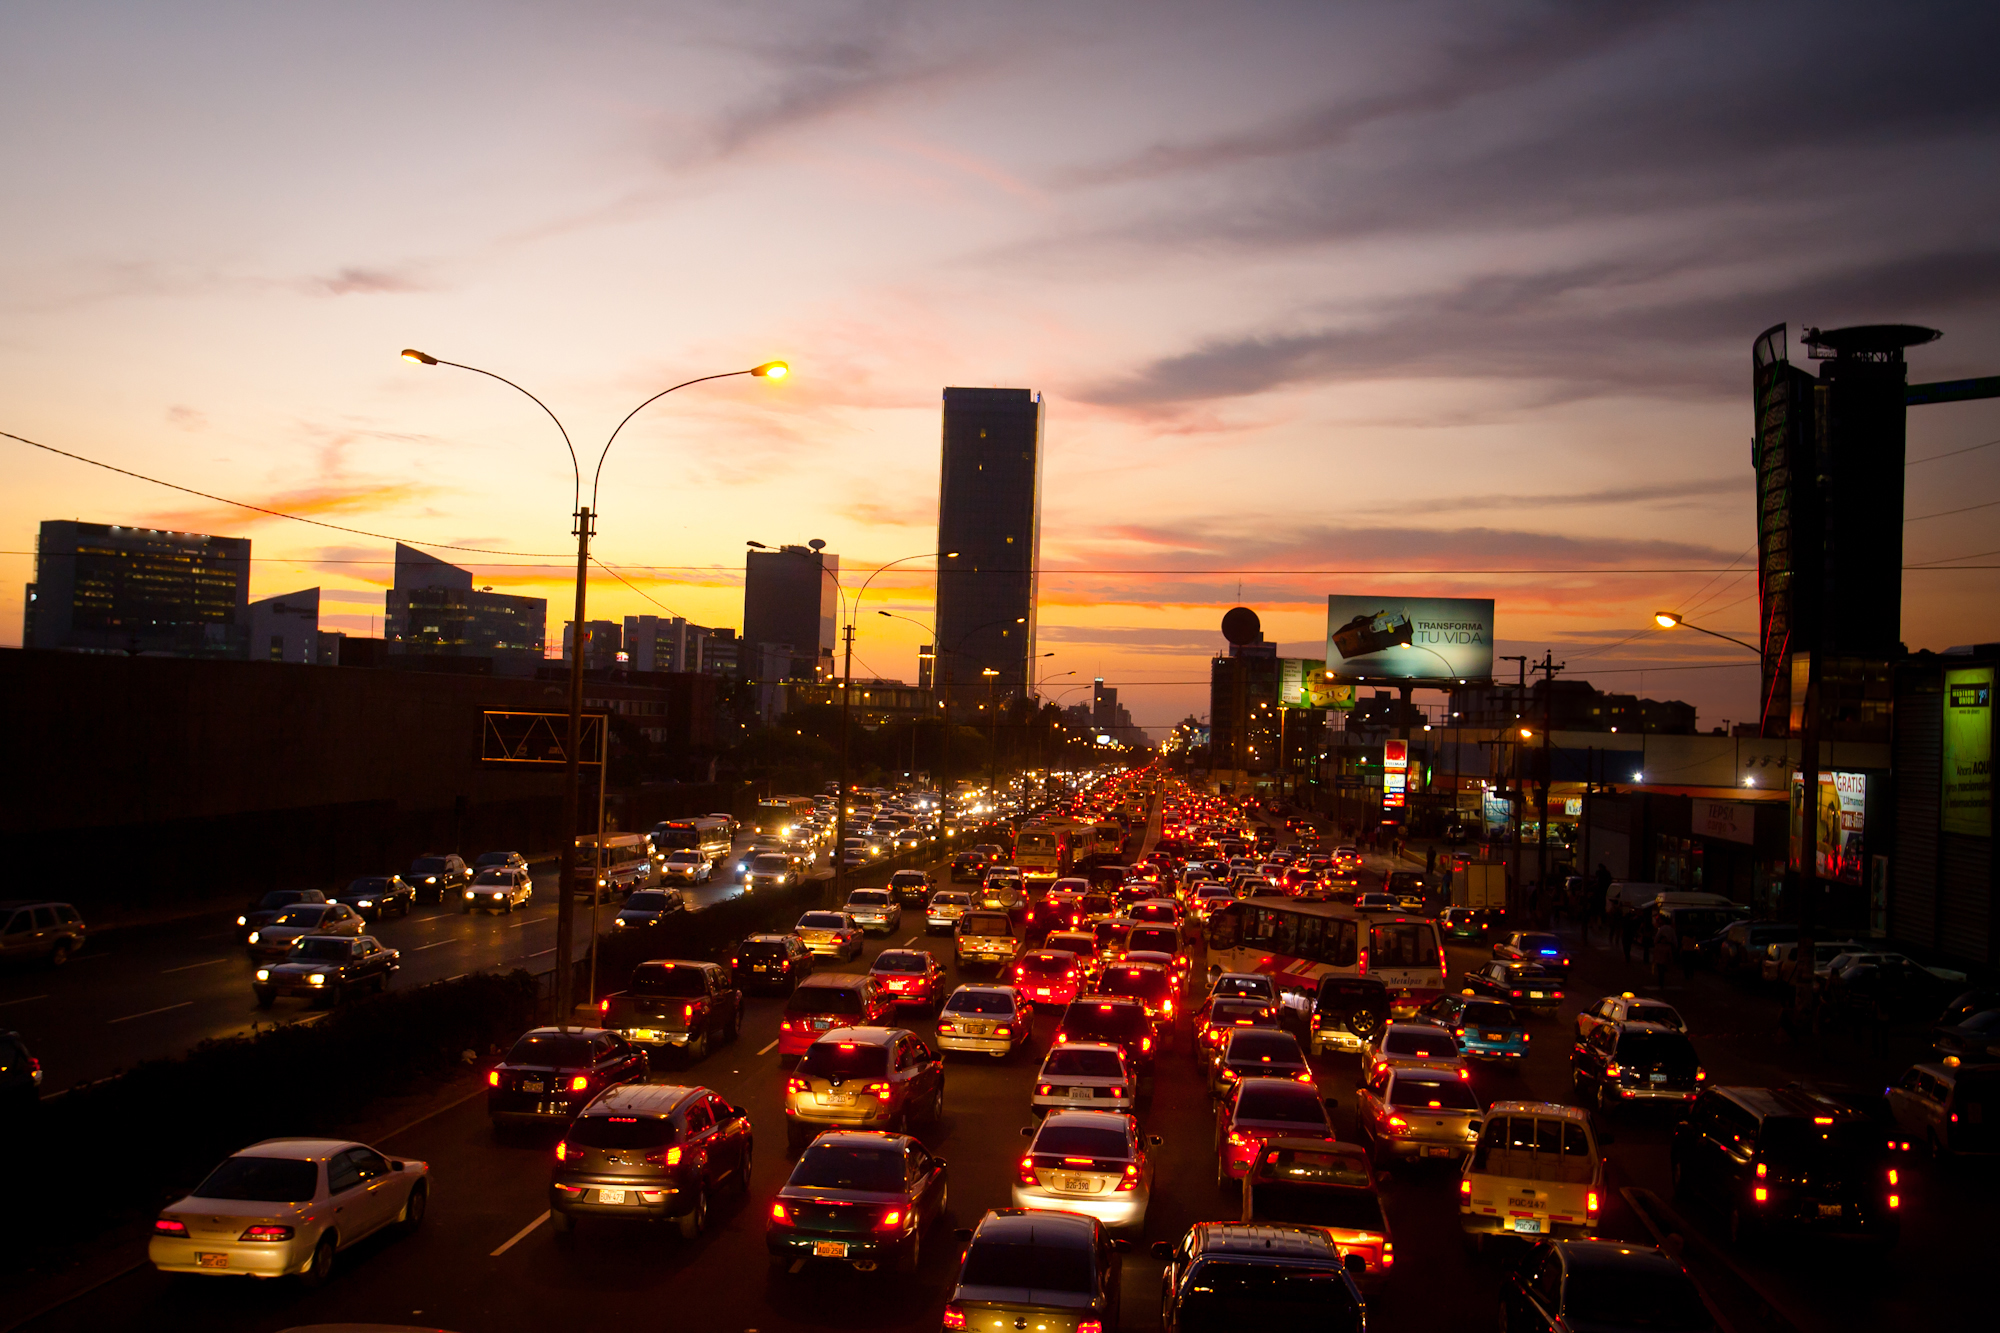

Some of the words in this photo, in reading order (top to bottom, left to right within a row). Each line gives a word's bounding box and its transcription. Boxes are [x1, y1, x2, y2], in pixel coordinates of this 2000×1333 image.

[1418, 622, 1483, 630] TRANSFORMA
[1418, 631, 1439, 643] TU
[1444, 631, 1483, 644] VIDA
[1959, 697, 1974, 705] UNION
[1837, 775, 1864, 793] GRATIS!
[1709, 804, 1734, 820] TEPSA
[1390, 977, 1422, 986] Metalpar
